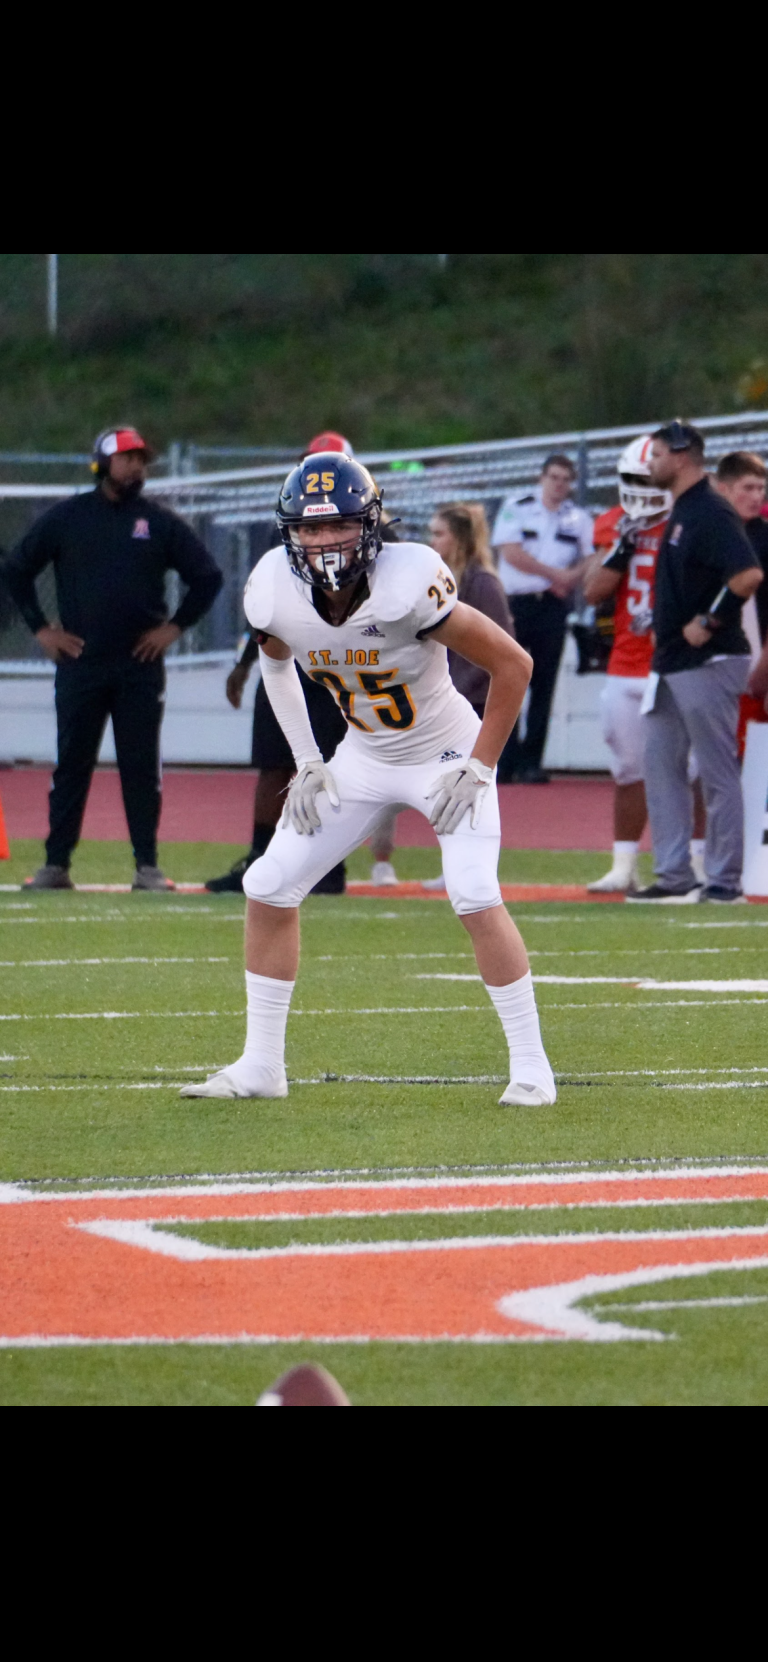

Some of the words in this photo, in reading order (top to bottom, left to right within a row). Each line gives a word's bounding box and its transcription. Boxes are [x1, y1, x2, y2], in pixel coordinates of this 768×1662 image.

[306, 472, 334, 493] 25
[307, 505, 334, 513] Riddell
[427, 567, 455, 611] 25
[308, 650, 338, 666] ST.
[345, 649, 379, 666] JOE
[308, 667, 416, 733] 25
